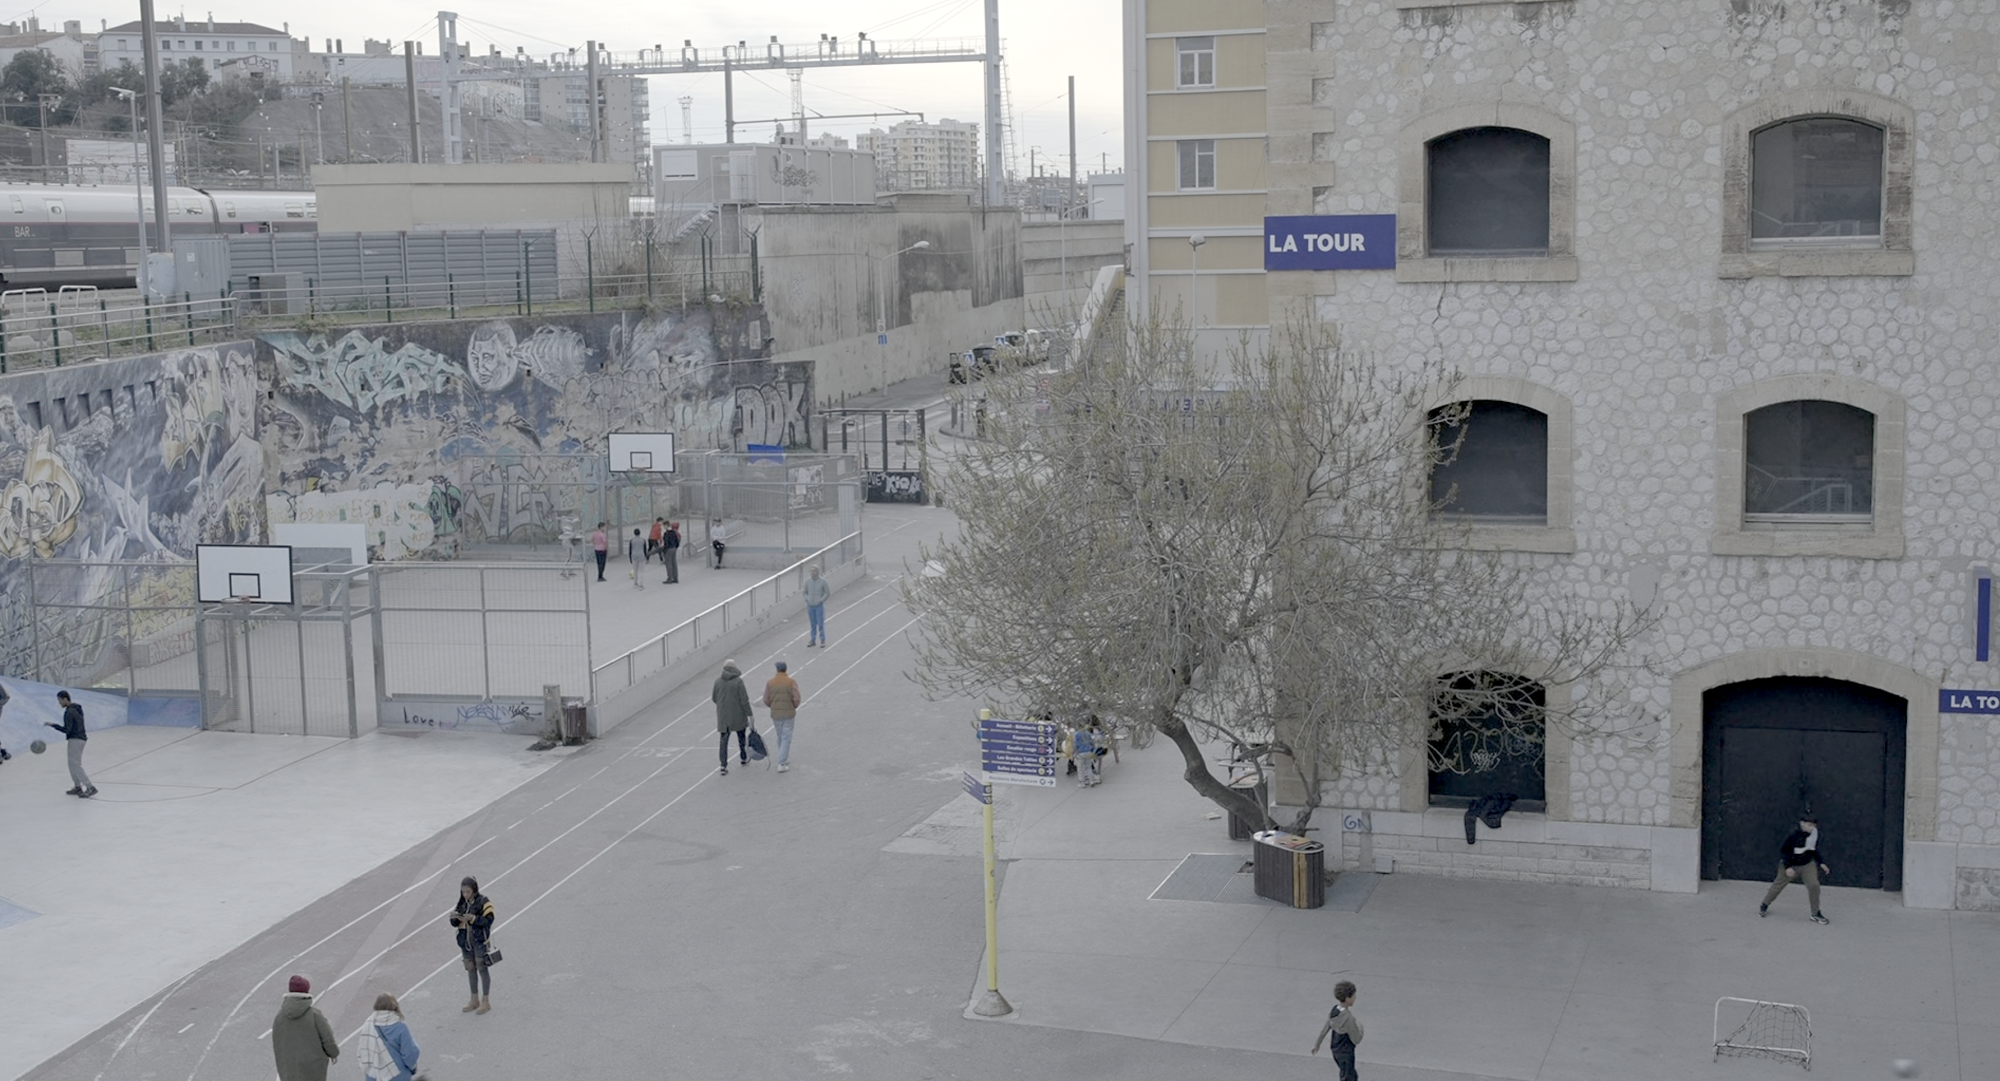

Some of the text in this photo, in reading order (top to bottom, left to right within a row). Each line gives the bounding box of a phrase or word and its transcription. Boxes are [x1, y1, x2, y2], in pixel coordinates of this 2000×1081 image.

[14, 226, 31, 238] BAR
[1269, 233, 1365, 252] LA TOUR
[1951, 695, 1973, 709] LA
